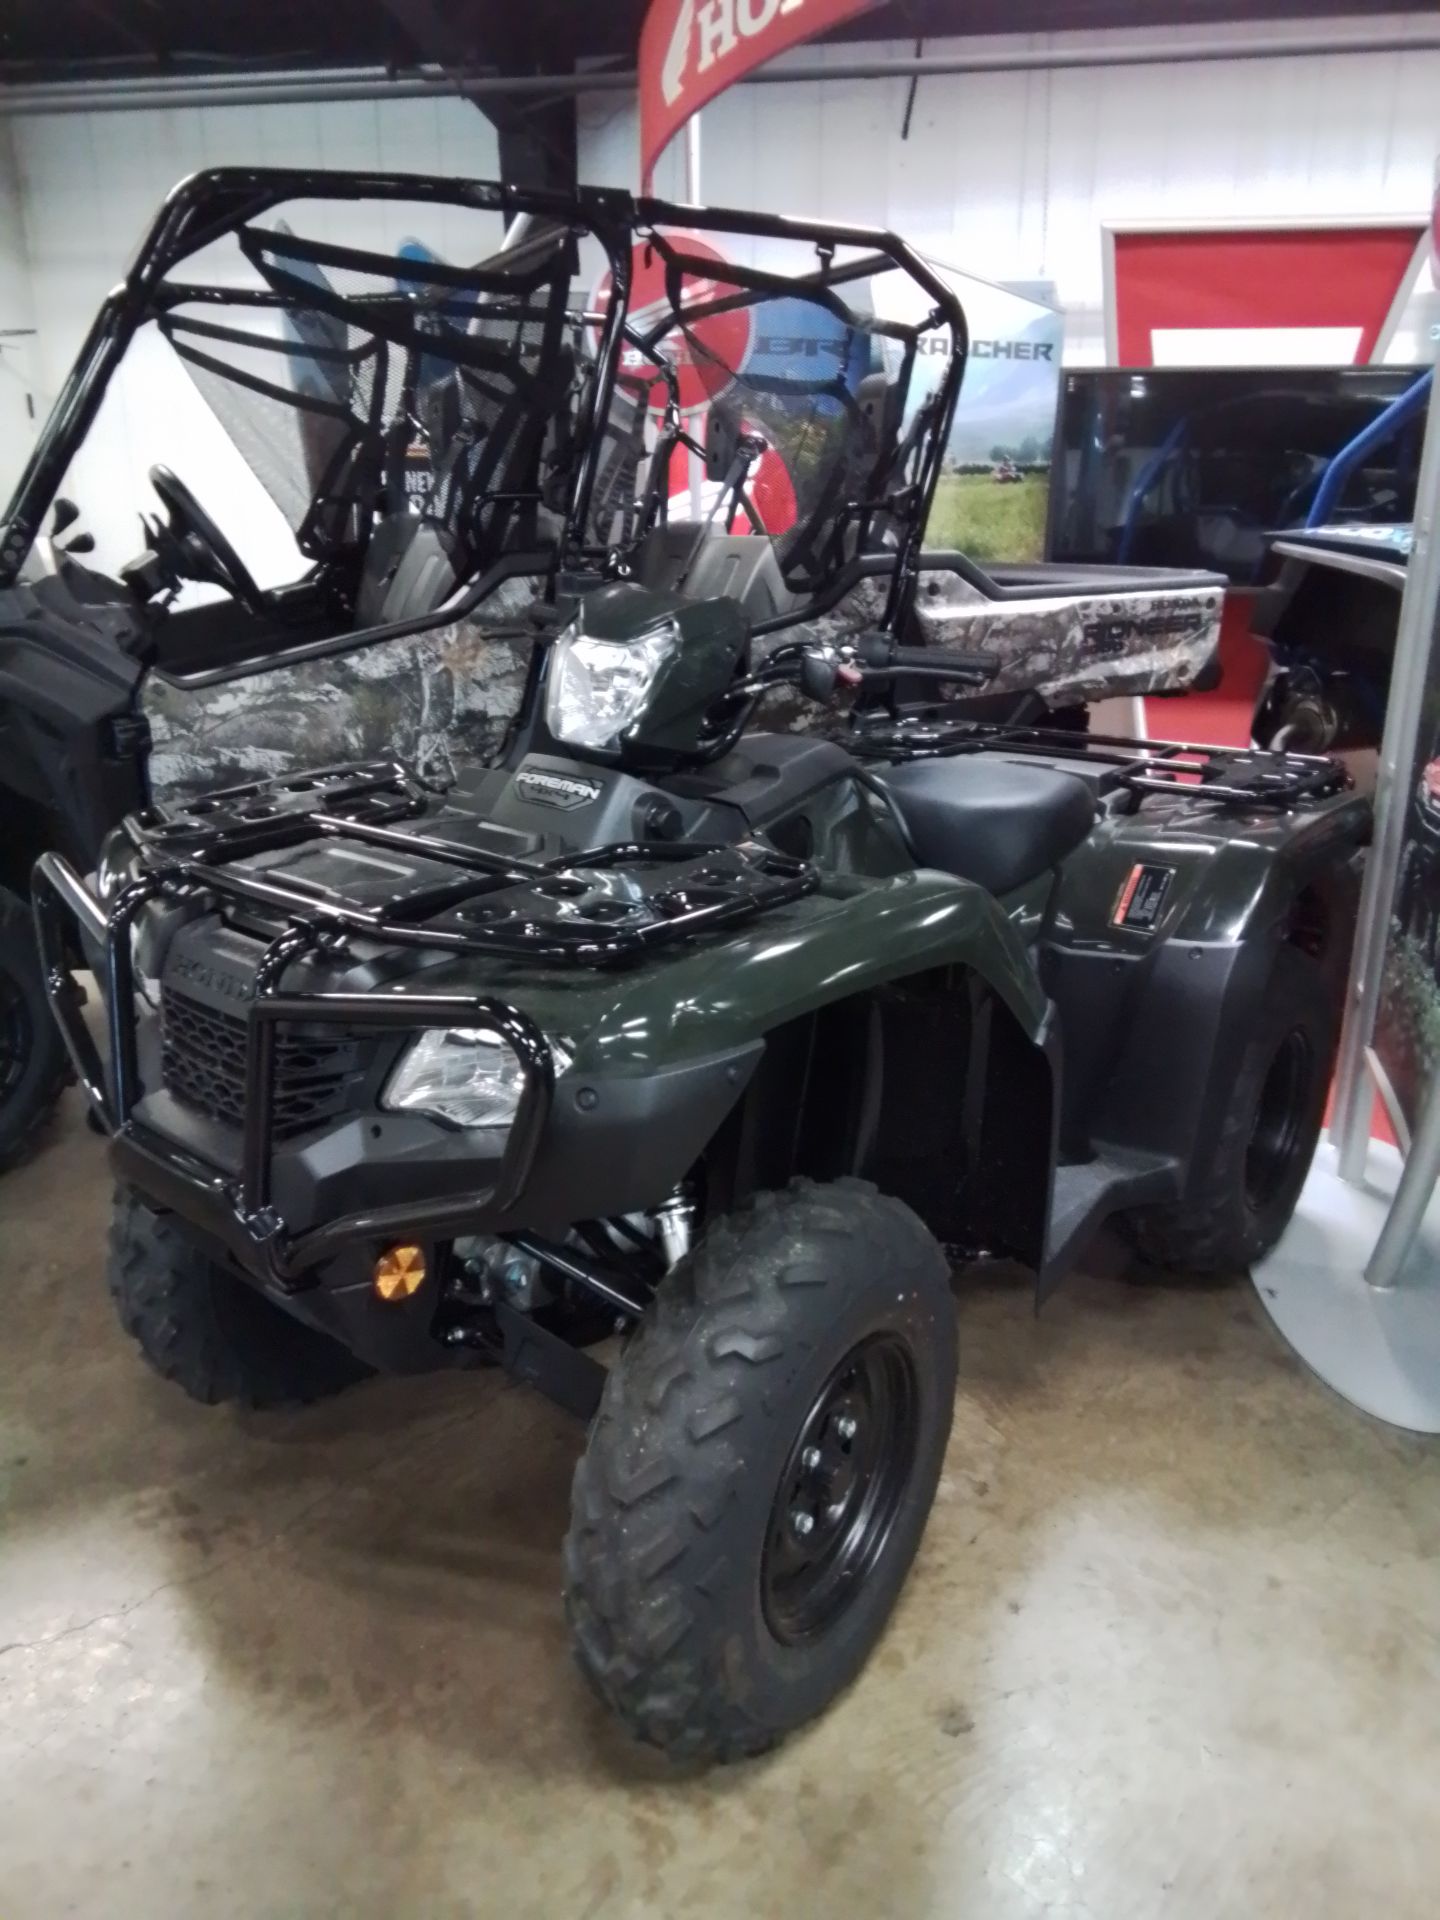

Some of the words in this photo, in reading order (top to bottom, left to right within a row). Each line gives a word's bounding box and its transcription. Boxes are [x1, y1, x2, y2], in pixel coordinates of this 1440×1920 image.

[697, 0, 804, 73] HO
[917, 336, 1054, 361] RACHER
[515, 772, 601, 800] FOREMAN
